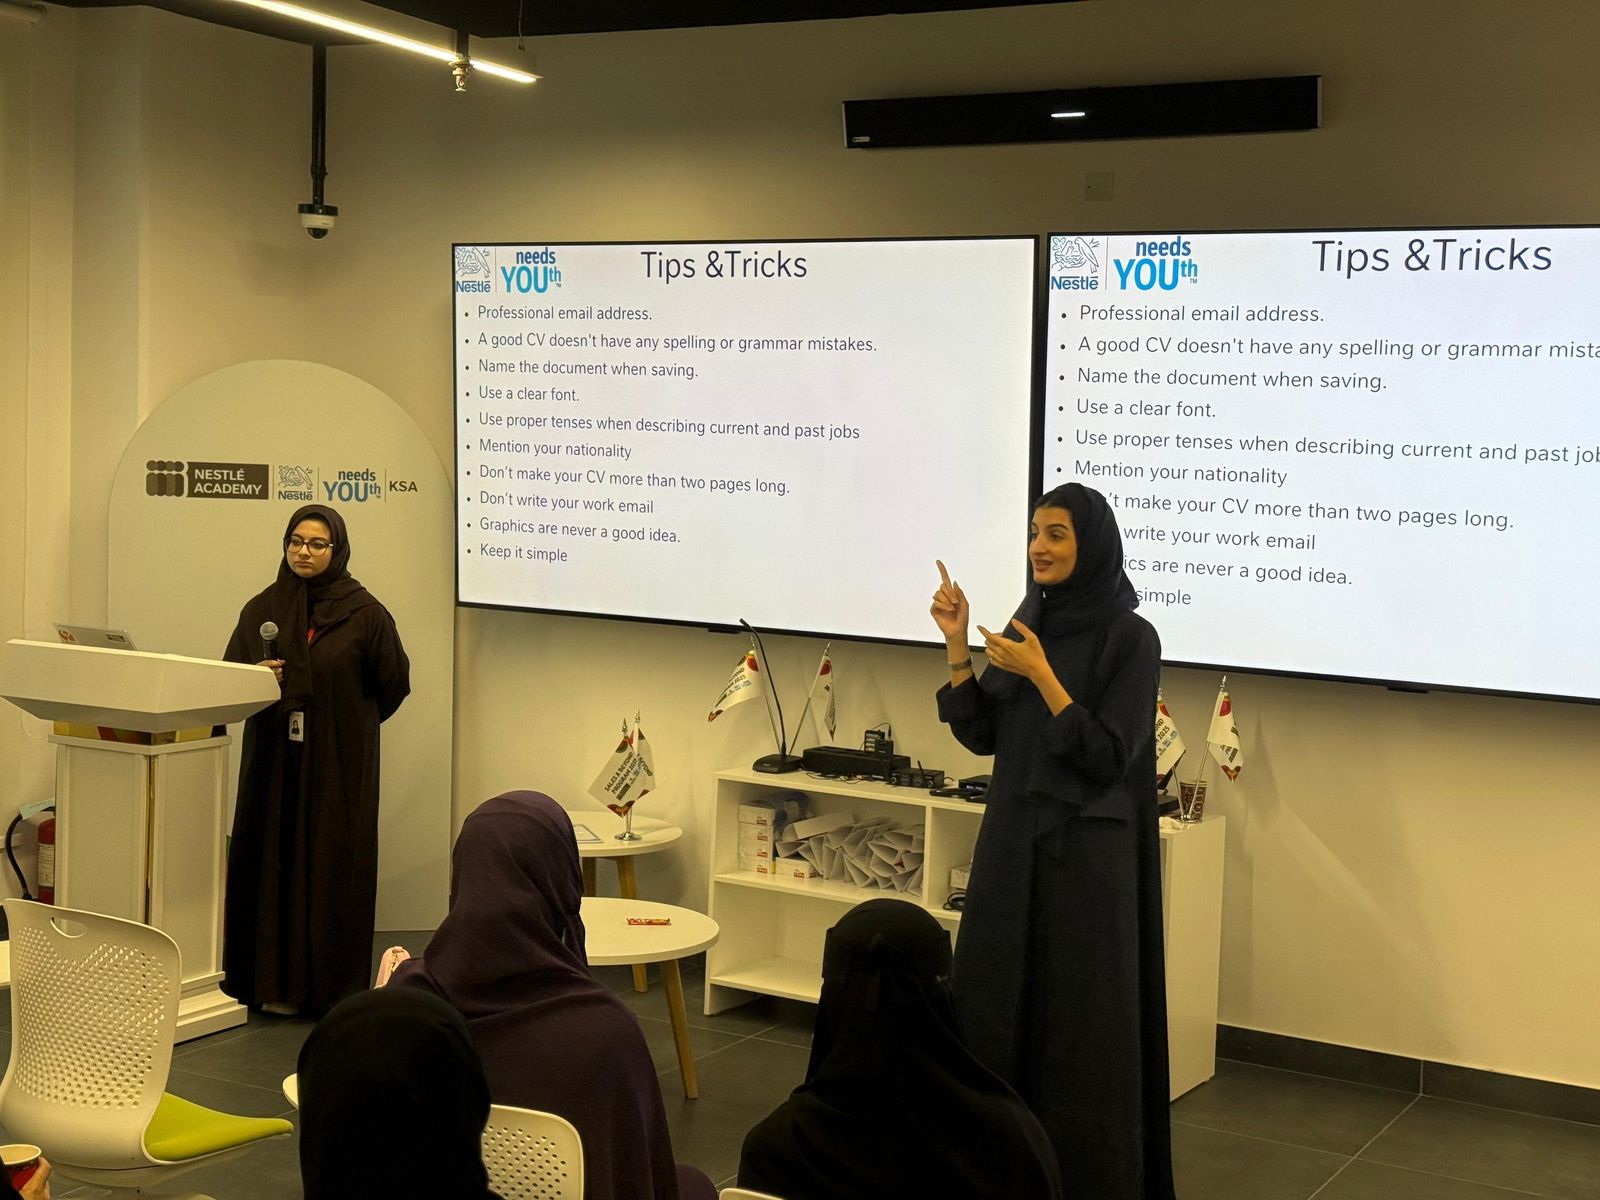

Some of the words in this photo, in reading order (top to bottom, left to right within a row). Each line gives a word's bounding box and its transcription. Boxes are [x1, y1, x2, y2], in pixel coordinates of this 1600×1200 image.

[516, 247, 556, 264] needs
[1136, 236, 1191, 256] needs
[640, 251, 695, 284] Tips
[706, 250, 807, 278] &Tricks
[1312, 240, 1389, 279] Tips
[1404, 238, 1551, 271] &Tricks
[500, 266, 561, 293] YOUth
[1113, 258, 1198, 291] YOUth
[478, 305, 554, 319] Professional
[558, 306, 592, 320] email
[597, 306, 652, 320] address.
[1080, 304, 1185, 321] Professional
[1191, 305, 1239, 321] email
[1246, 305, 1324, 322] address.
[478, 332, 488, 345] A
[491, 333, 522, 349] good
[527, 332, 546, 346] CV
[549, 333, 597, 347] doesn't
[601, 334, 631, 348] have
[635, 337, 659, 352] any
[663, 335, 715, 352] spelling
[720, 339, 734, 349] or
[738, 339, 803, 353] grammar
[808, 336, 877, 351] mistakes.
[1078, 336, 1091, 351] A
[1096, 337, 1139, 356] good
[1146, 337, 1172, 352] CV
[1177, 337, 1244, 354] doesn't
[1250, 338, 1293, 354] have
[1299, 342, 1333, 359] any
[1339, 339, 1414, 360] spelling
[1421, 344, 1442, 356] or
[1448, 344, 1542, 360] grammar
[1549, 341, 1600, 358] mista
[479, 358, 515, 373] Name
[519, 360, 539, 373] the
[543, 360, 607, 375] document
[611, 362, 647, 376] when
[651, 363, 698, 380] saving.
[1078, 367, 1128, 383] Name
[1134, 368, 1161, 384] the
[1167, 369, 1257, 386] document
[1263, 371, 1313, 387] when
[1320, 372, 1386, 393] saving.
[479, 385, 502, 399] Use
[506, 389, 513, 399] a
[517, 387, 547, 400] clear
[551, 387, 579, 402] font.
[1077, 398, 1108, 414] Use
[1114, 403, 1123, 415] a
[1129, 400, 1171, 416] clear
[1176, 401, 1215, 417] font.
[479, 412, 503, 426] Use
[507, 416, 548, 429] proper
[551, 416, 592, 429] tenses
[596, 416, 631, 430] when
[636, 417, 705, 437] describing
[710, 422, 759, 435] current
[763, 422, 789, 436] and
[795, 425, 825, 440] past
[829, 424, 860, 441] jobs
[480, 438, 530, 453] Mention
[534, 444, 562, 457] your
[566, 443, 632, 461] nationality
[1076, 429, 1107, 445] Use
[1113, 434, 1170, 450] proper
[1175, 434, 1233, 450] tenses
[1239, 435, 1288, 452] when
[1295, 437, 1394, 460] describing
[1401, 444, 1472, 458] current
[1479, 443, 1517, 460] and
[1525, 447, 1569, 464] past
[1574, 446, 1600, 466] jo
[194, 468, 245, 481] NESTLÉ
[338, 468, 376, 481] needs
[517, 467, 551, 481] make
[554, 472, 583, 485] your
[586, 469, 606, 484] CV
[610, 474, 643, 486] more
[647, 473, 676, 487] than
[680, 476, 705, 489] two
[710, 479, 751, 494] pages
[756, 478, 790, 496] long.
[1075, 460, 1143, 477] Mention
[1150, 467, 1189, 482] your
[1194, 466, 1287, 488] nationality
[193, 482, 263, 495] ACADEMY
[323, 480, 381, 502] YOUth
[389, 480, 418, 492] KSA
[516, 494, 547, 508] write
[551, 498, 579, 511] your
[582, 498, 614, 511] work
[618, 500, 653, 513] email
[1125, 494, 1172, 510] make
[1177, 500, 1216, 515] your
[1222, 498, 1249, 514] CV
[1255, 504, 1302, 517] more
[1308, 502, 1349, 519] than
[1356, 506, 1391, 522] two
[1398, 511, 1457, 528] pages
[1465, 509, 1513, 532] long.
[480, 517, 534, 534] Graphics
[538, 524, 558, 535] are
[562, 525, 597, 537] never
[600, 528, 608, 538] a
[612, 527, 645, 542] good
[649, 528, 680, 543] idea.
[1124, 525, 1165, 541] write
[1171, 531, 1211, 545] your
[1216, 531, 1260, 547] work
[1266, 534, 1315, 550] email
[480, 543, 511, 560] Keep
[515, 545, 523, 559] it
[527, 547, 567, 564] simple
[1152, 560, 1179, 573] are
[1185, 563, 1234, 576] never
[1239, 566, 1249, 578] a
[1256, 566, 1301, 583] good
[1309, 567, 1352, 585] idea.
[1136, 588, 1191, 606] simple
[604, 775, 618, 792] SALES
[618, 751, 633, 773] BEYOND
[611, 769, 631, 795] PROGRAM
